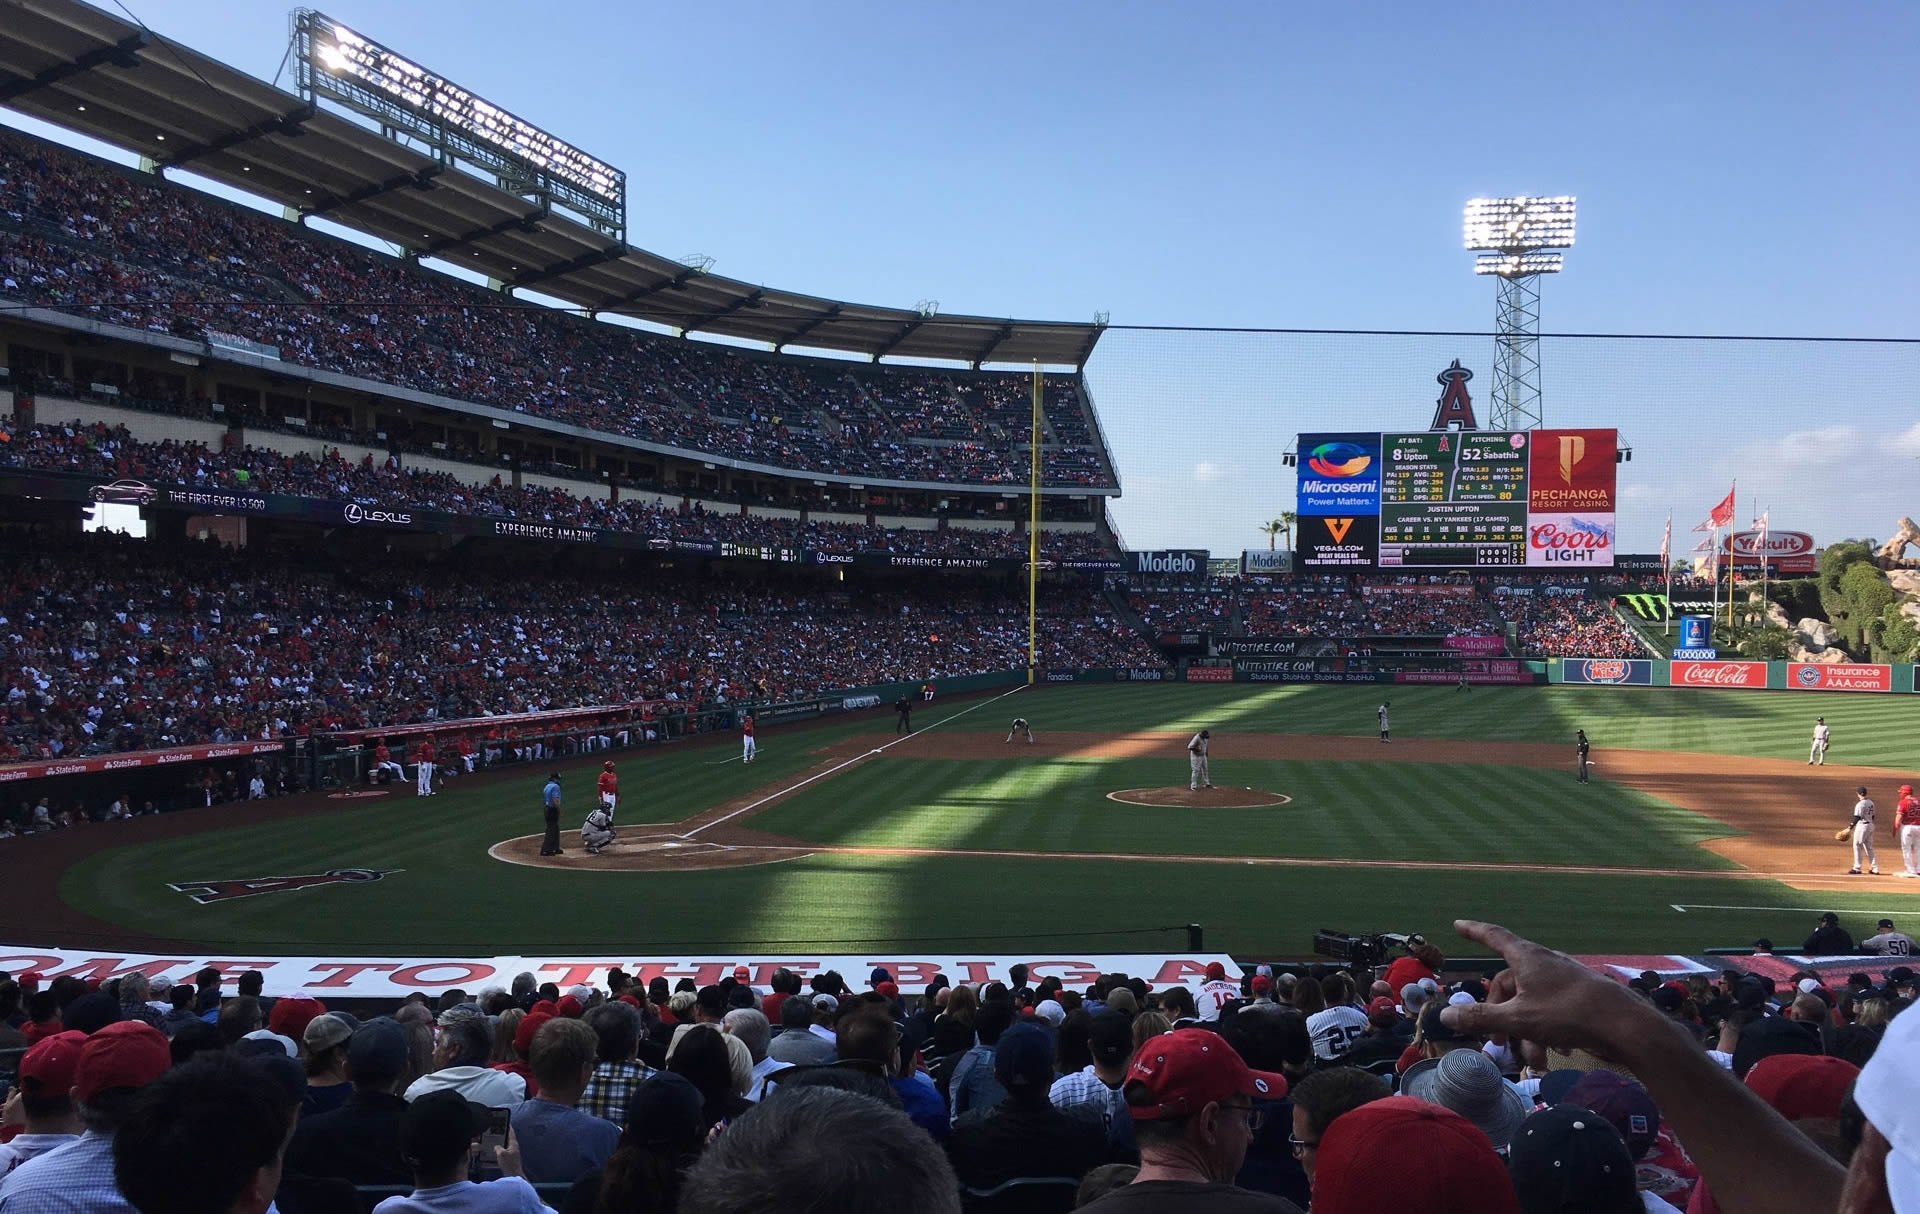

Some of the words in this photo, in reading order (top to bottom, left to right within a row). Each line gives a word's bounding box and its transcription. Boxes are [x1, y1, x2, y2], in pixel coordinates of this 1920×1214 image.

[1393, 449, 1402, 460] 8
[1462, 448, 1481, 460] 52
[1302, 480, 1376, 493] Microsemi
[168, 490, 186, 502] THE
[188, 492, 236, 508] FIRST-EVER
[237, 498, 248, 508] LS
[248, 498, 264, 510] 500
[1500, 492, 1512, 500] 80
[1532, 490, 1608, 500] PECHANGA
[364, 510, 411, 524] LEXUS
[496, 522, 554, 538] EXPERIENCE
[558, 528, 598, 542] AMAZING
[1530, 523, 1609, 550] Coors
[1138, 552, 1196, 572] Modelo
[1252, 554, 1286, 568] Modelo
[1546, 550, 1595, 562] LIGHT
[892, 557, 942, 566] EXPERIENCE
[946, 560, 988, 568] AMAZING
[1674, 651, 1716, 659] $1,000,000
[1590, 660, 1624, 670] Jersey
[1826, 666, 1880, 676] Insurance
[1047, 672, 1073, 680] Fanatics
[1130, 668, 1160, 680] Modelo
[1826, 678, 1880, 688] AAA.com
[1888, 940, 1908, 956] 50
[302, 962, 496, 987] TO
[538, 962, 820, 986] THE
[865, 961, 1098, 985] BIG
[1146, 960, 1241, 984] A
[1204, 982, 1238, 992] ANDERSON
[1328, 1026, 1361, 1055] 25
